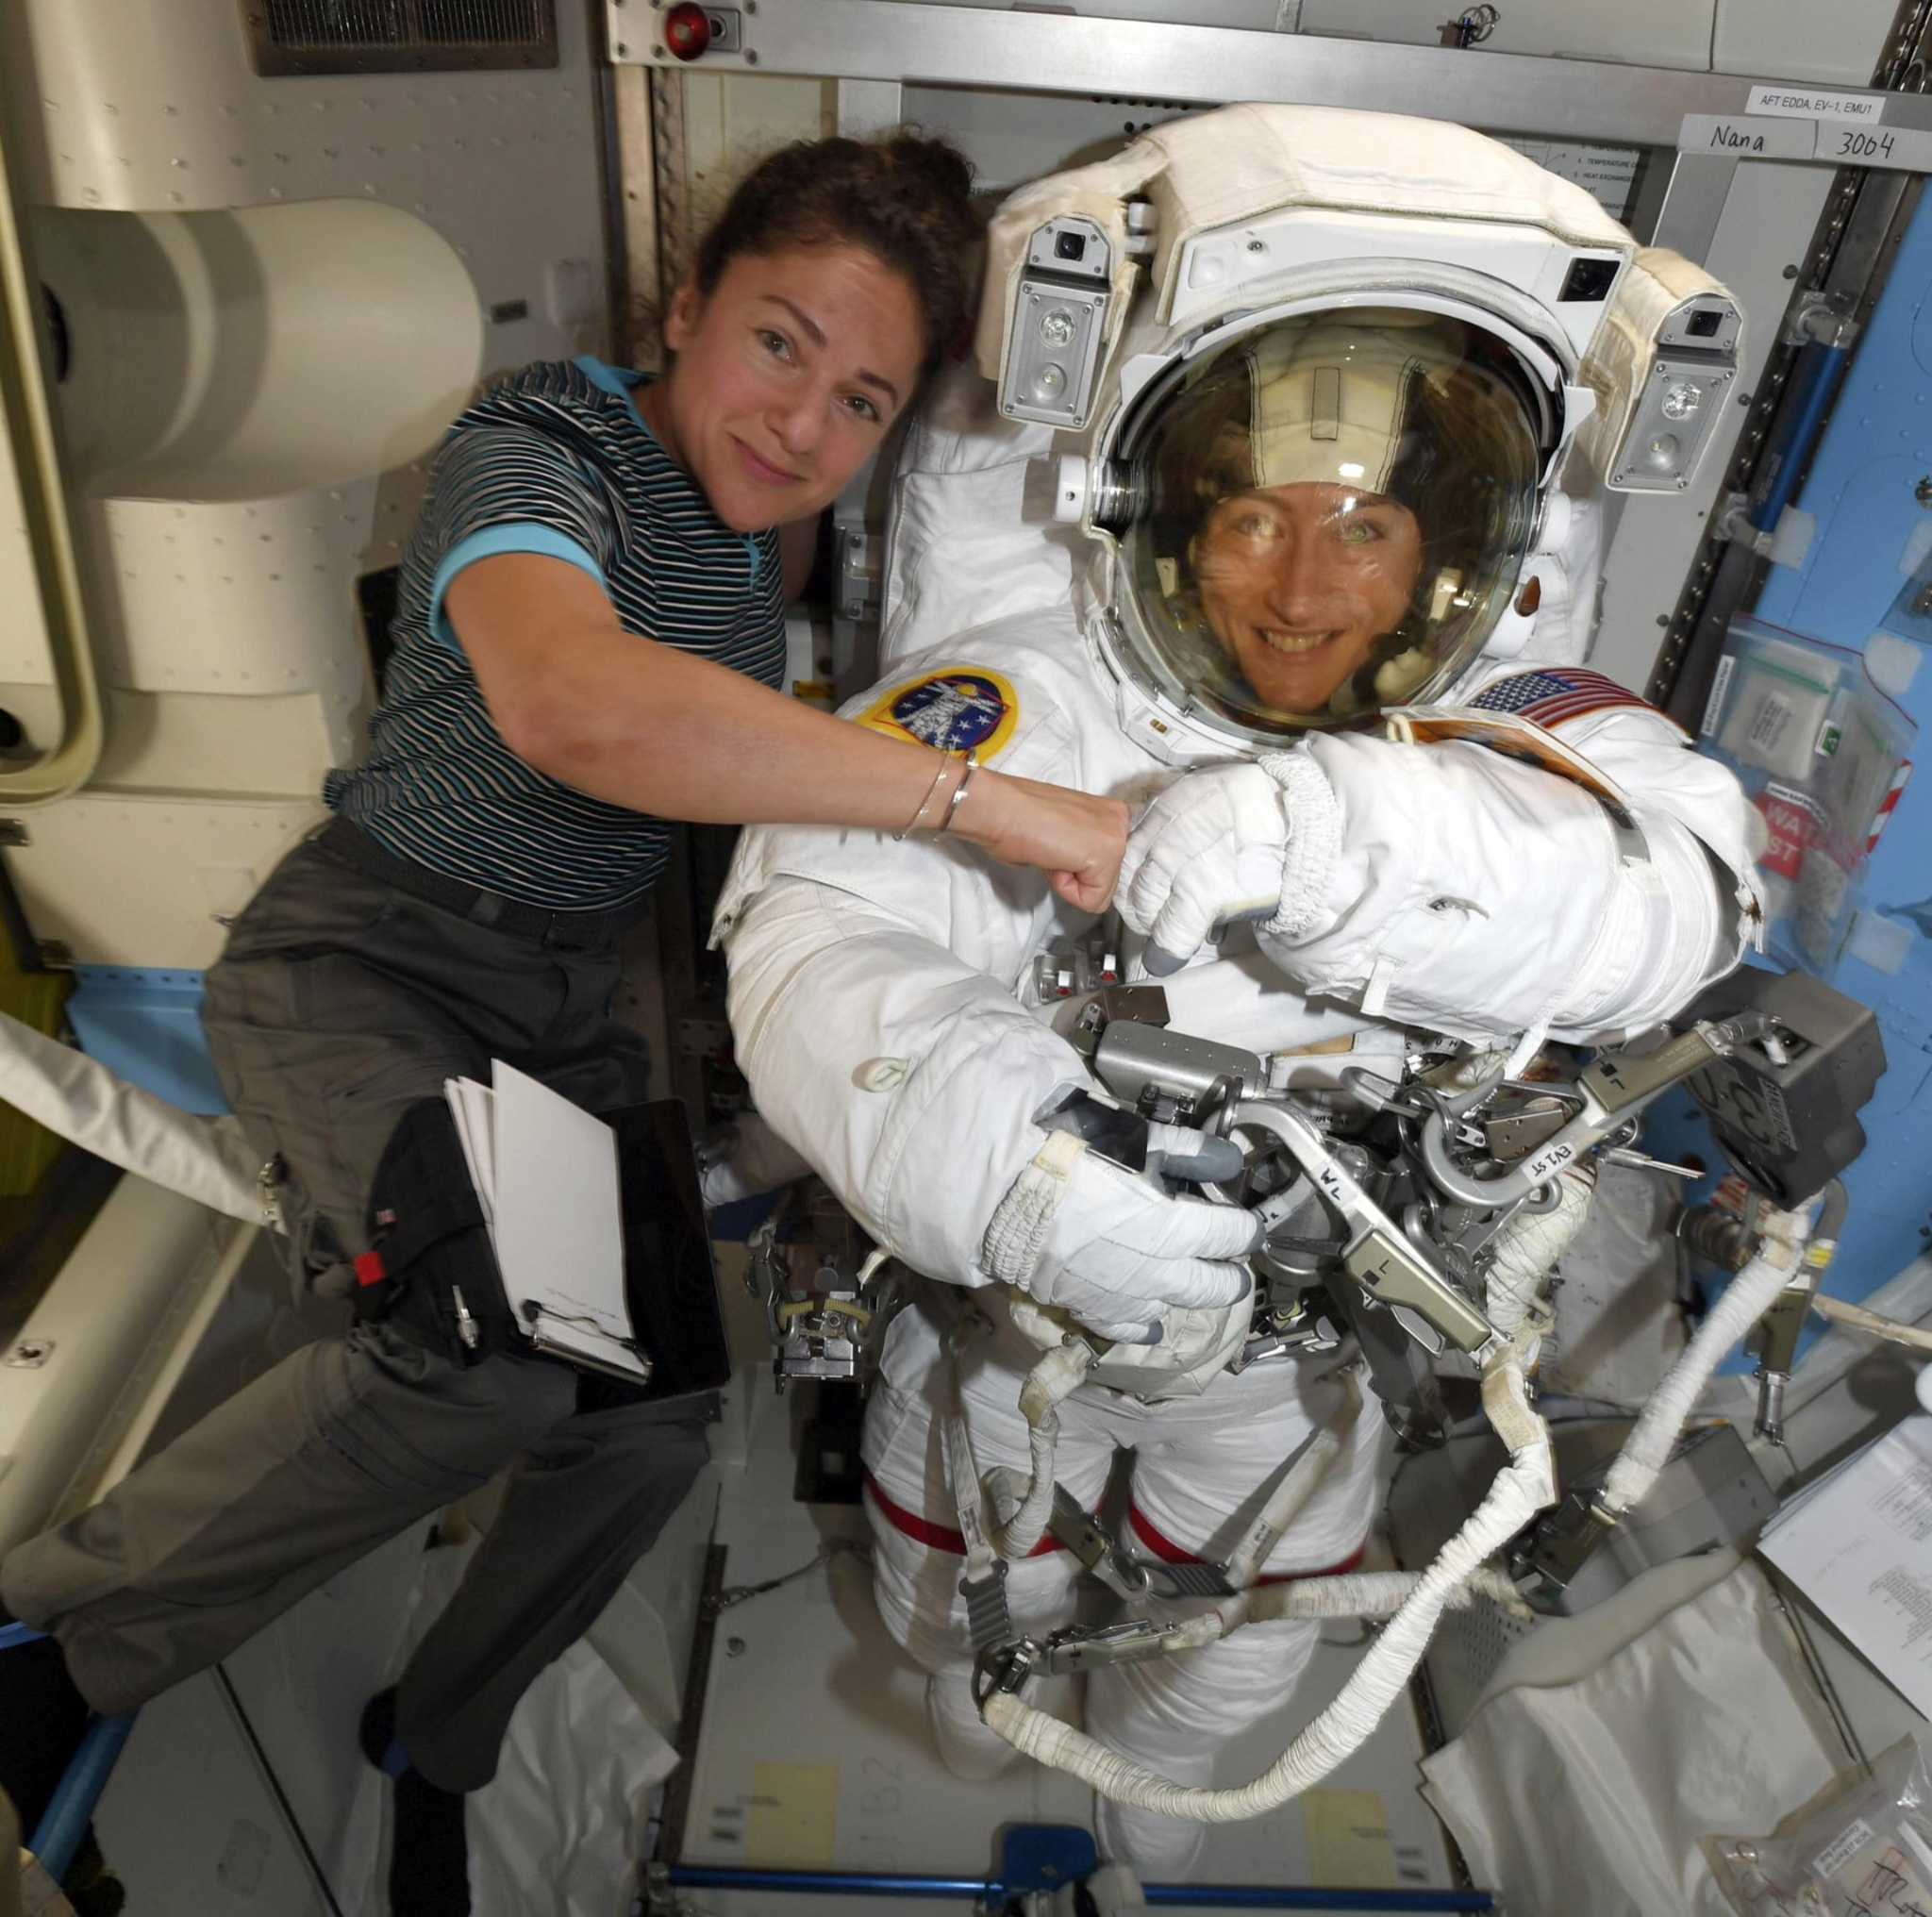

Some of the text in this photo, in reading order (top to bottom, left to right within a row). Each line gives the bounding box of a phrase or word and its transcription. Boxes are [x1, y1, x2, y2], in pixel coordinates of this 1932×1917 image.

[1760, 94, 1780, 107] AFT
[1843, 102, 1873, 114] EMU1
[1709, 125, 1765, 152] Nana
[1836, 130, 1895, 159] 3004
